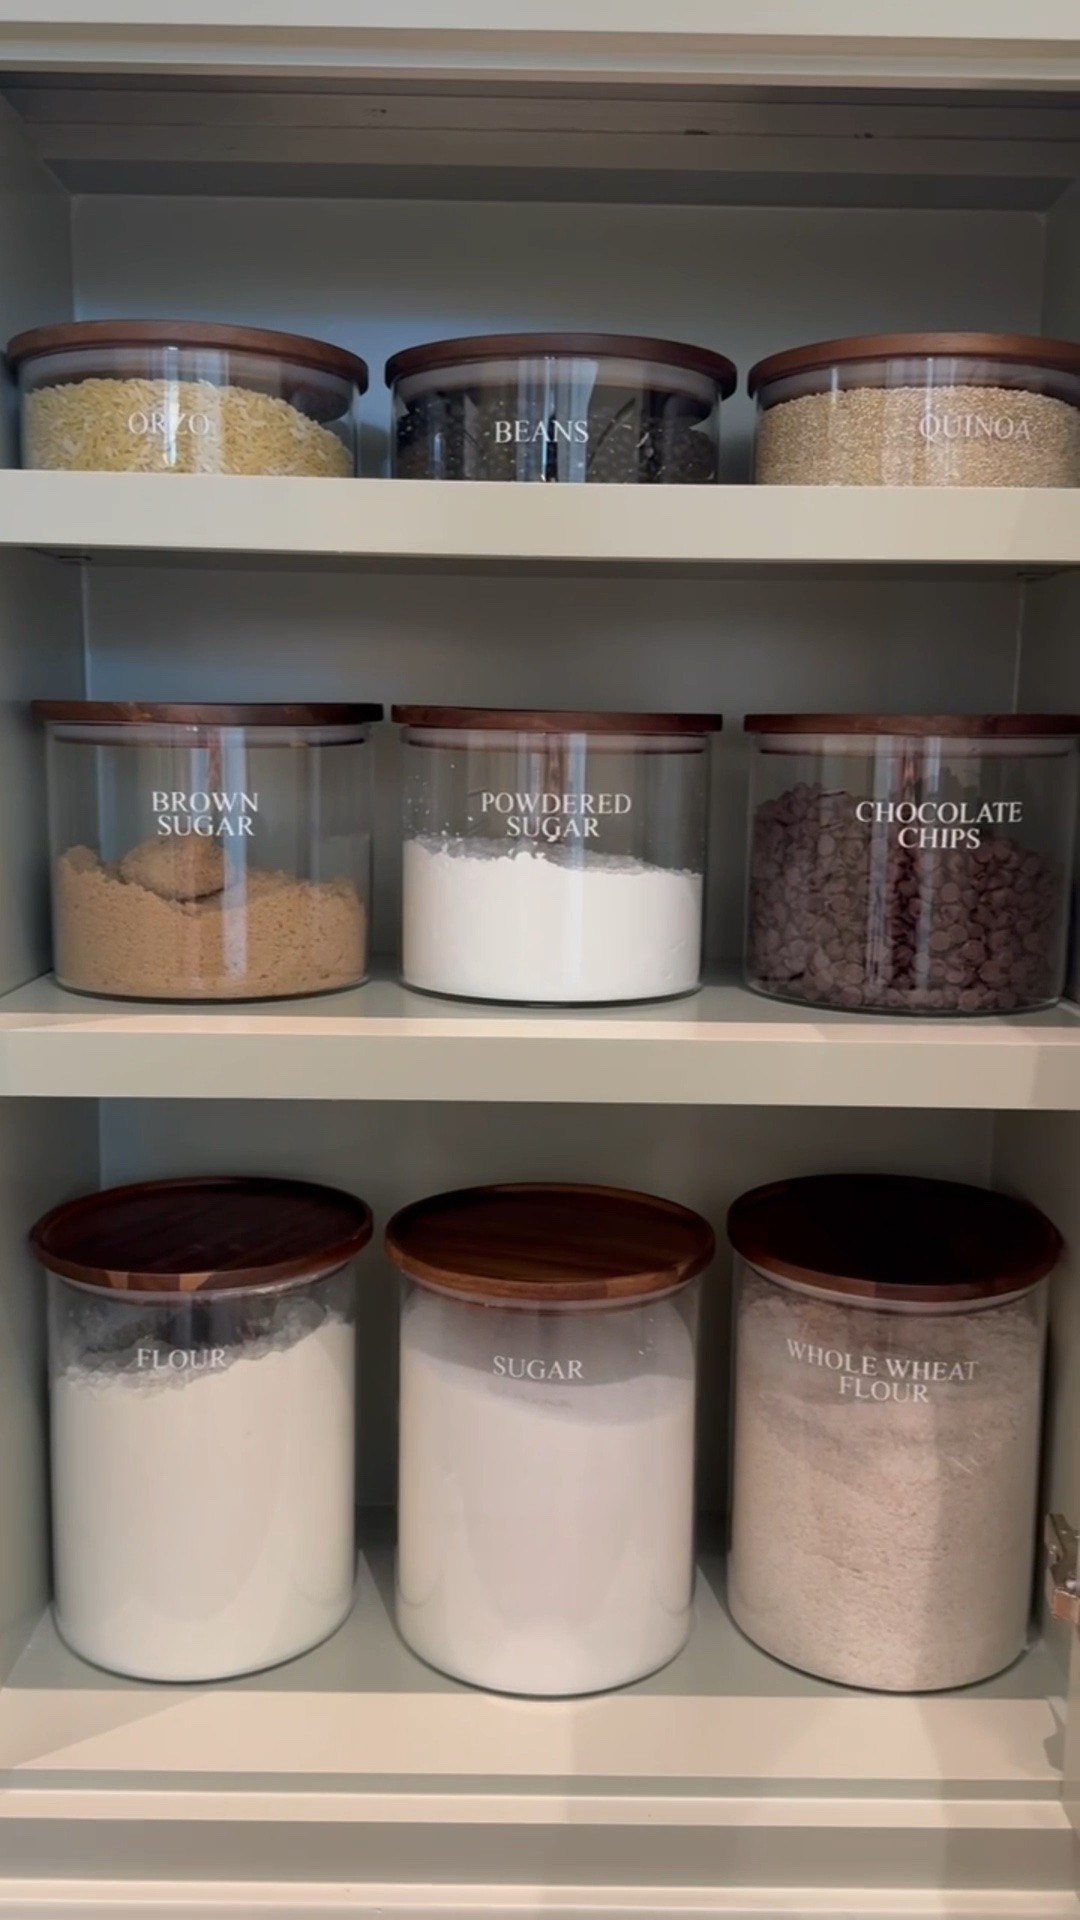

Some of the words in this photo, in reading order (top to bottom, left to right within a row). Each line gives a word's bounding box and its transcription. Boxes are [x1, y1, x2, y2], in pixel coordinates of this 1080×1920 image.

[128, 412, 209, 435] ORZO
[494, 420, 589, 443] BEANS
[919, 413, 1031, 442] QUINOA
[152, 791, 258, 812] BROWN
[481, 792, 632, 814] POWDERED
[856, 801, 1023, 823] CHOCOLATE
[157, 815, 255, 836] SUGAR
[507, 816, 600, 838] SUGAR
[898, 827, 981, 849] CHIPS
[137, 1348, 227, 1369] FLOUR
[492, 1355, 584, 1379] SUGAR
[786, 1338, 878, 1376] WHOLE
[885, 1358, 979, 1381] WHEAT
[839, 1376, 929, 1403] FLOUR
